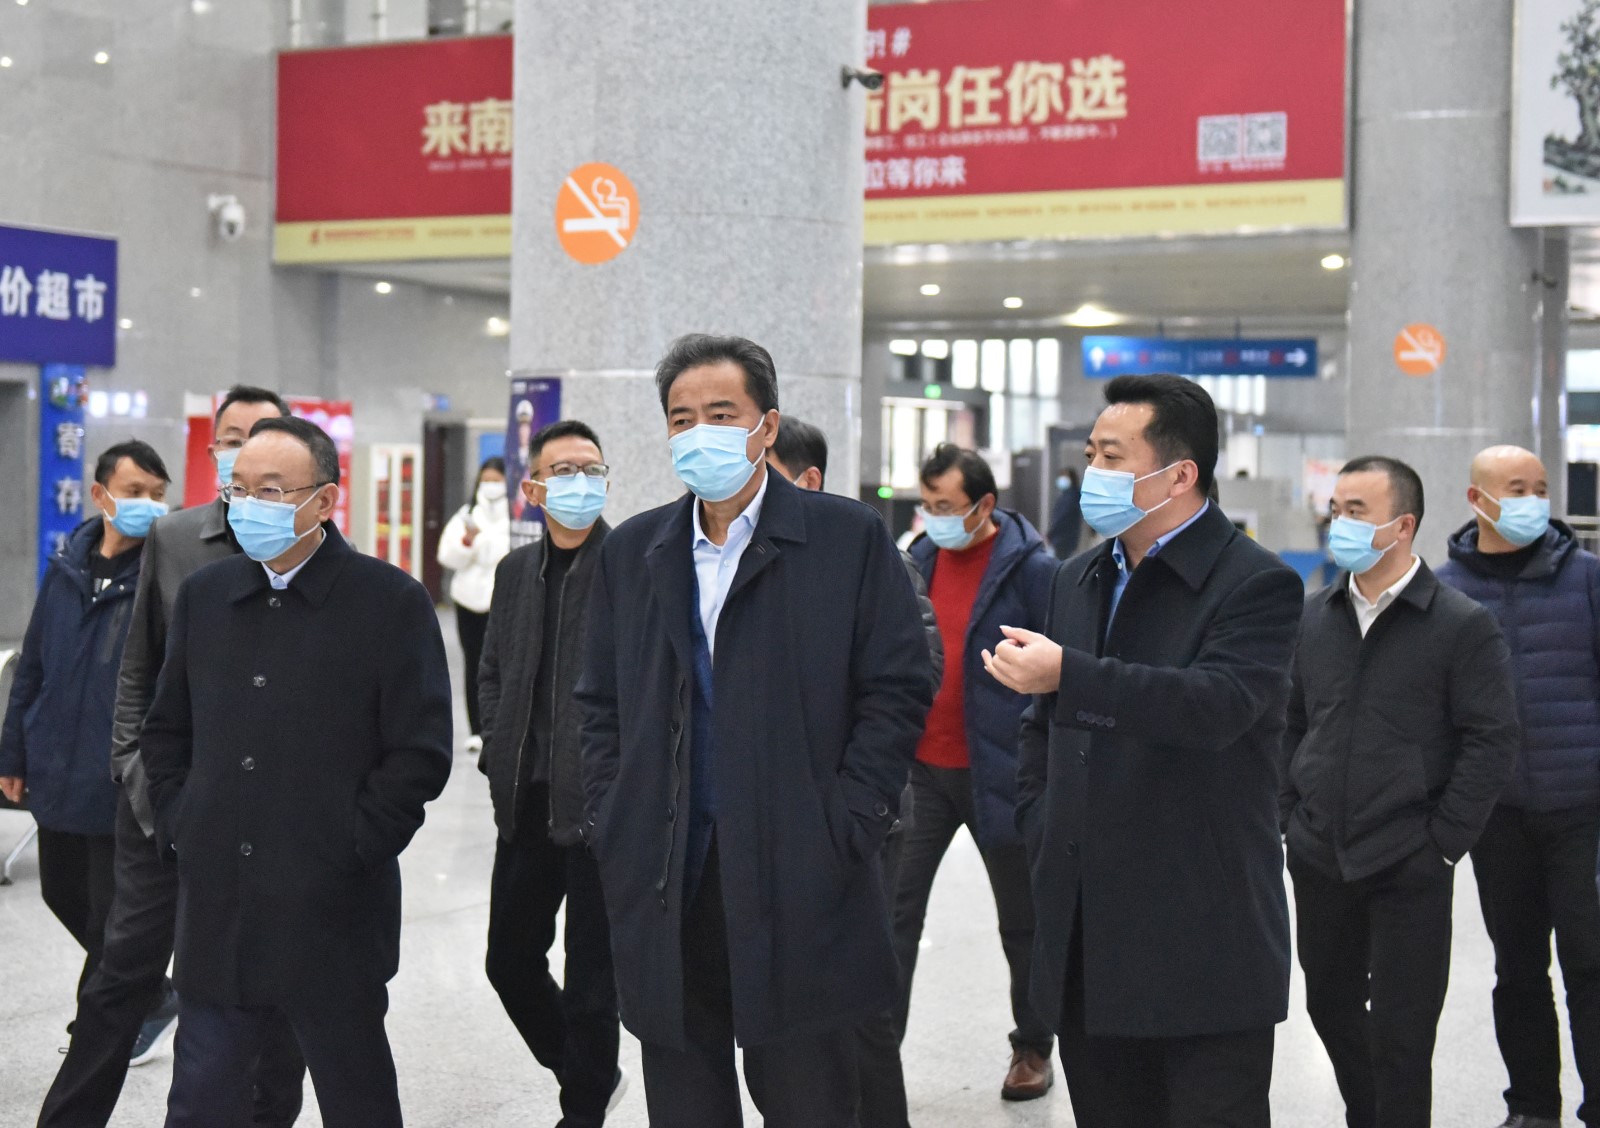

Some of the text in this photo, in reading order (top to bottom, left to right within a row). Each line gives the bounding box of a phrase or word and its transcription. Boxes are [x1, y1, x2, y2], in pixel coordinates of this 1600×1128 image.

[422, 98, 513, 156] 来南
[0, 265, 107, 322] 价超市
